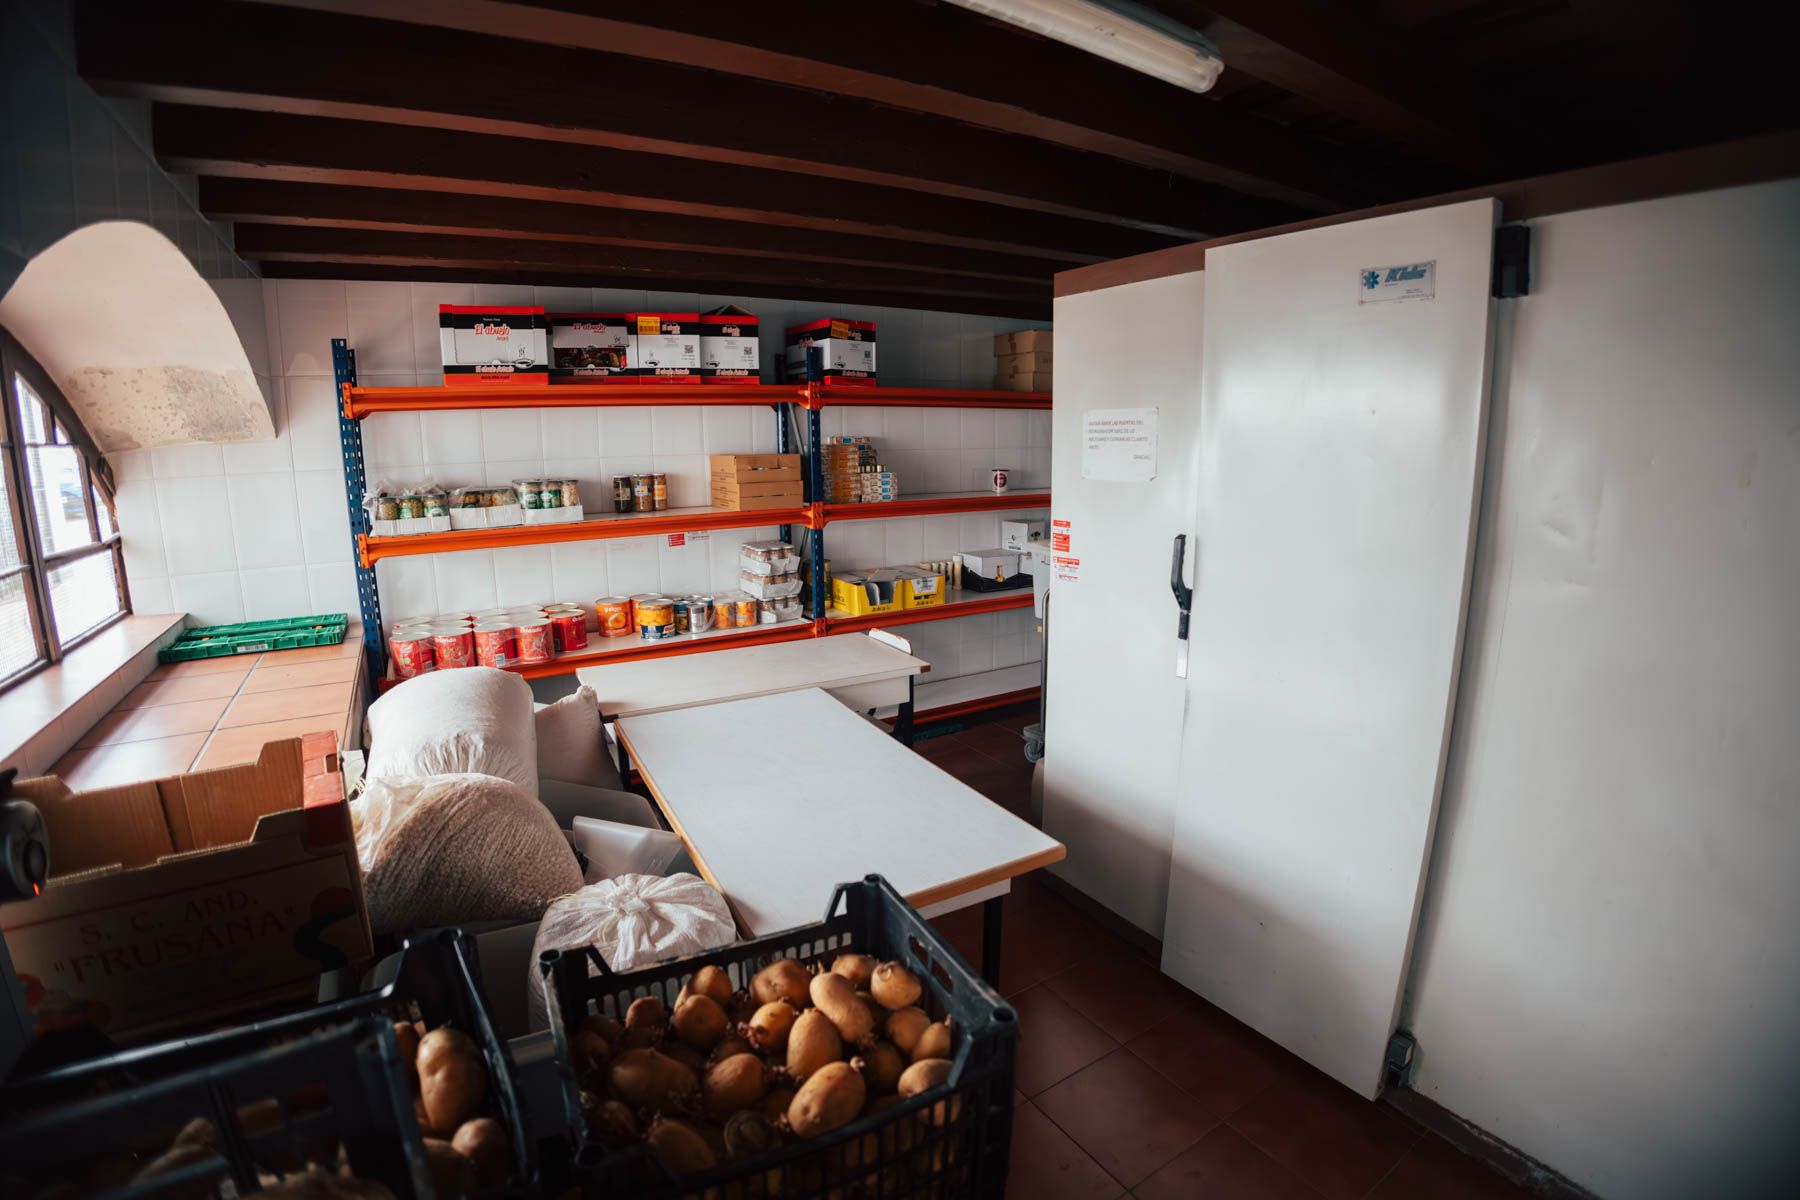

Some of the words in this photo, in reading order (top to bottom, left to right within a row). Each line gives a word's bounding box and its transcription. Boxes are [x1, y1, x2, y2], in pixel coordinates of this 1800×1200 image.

[474, 323, 484, 335] El
[485, 323, 511, 336] abuelo
[79, 923, 112, 945] S.
[130, 911, 165, 933] C.
[184, 890, 260, 921] AND.
